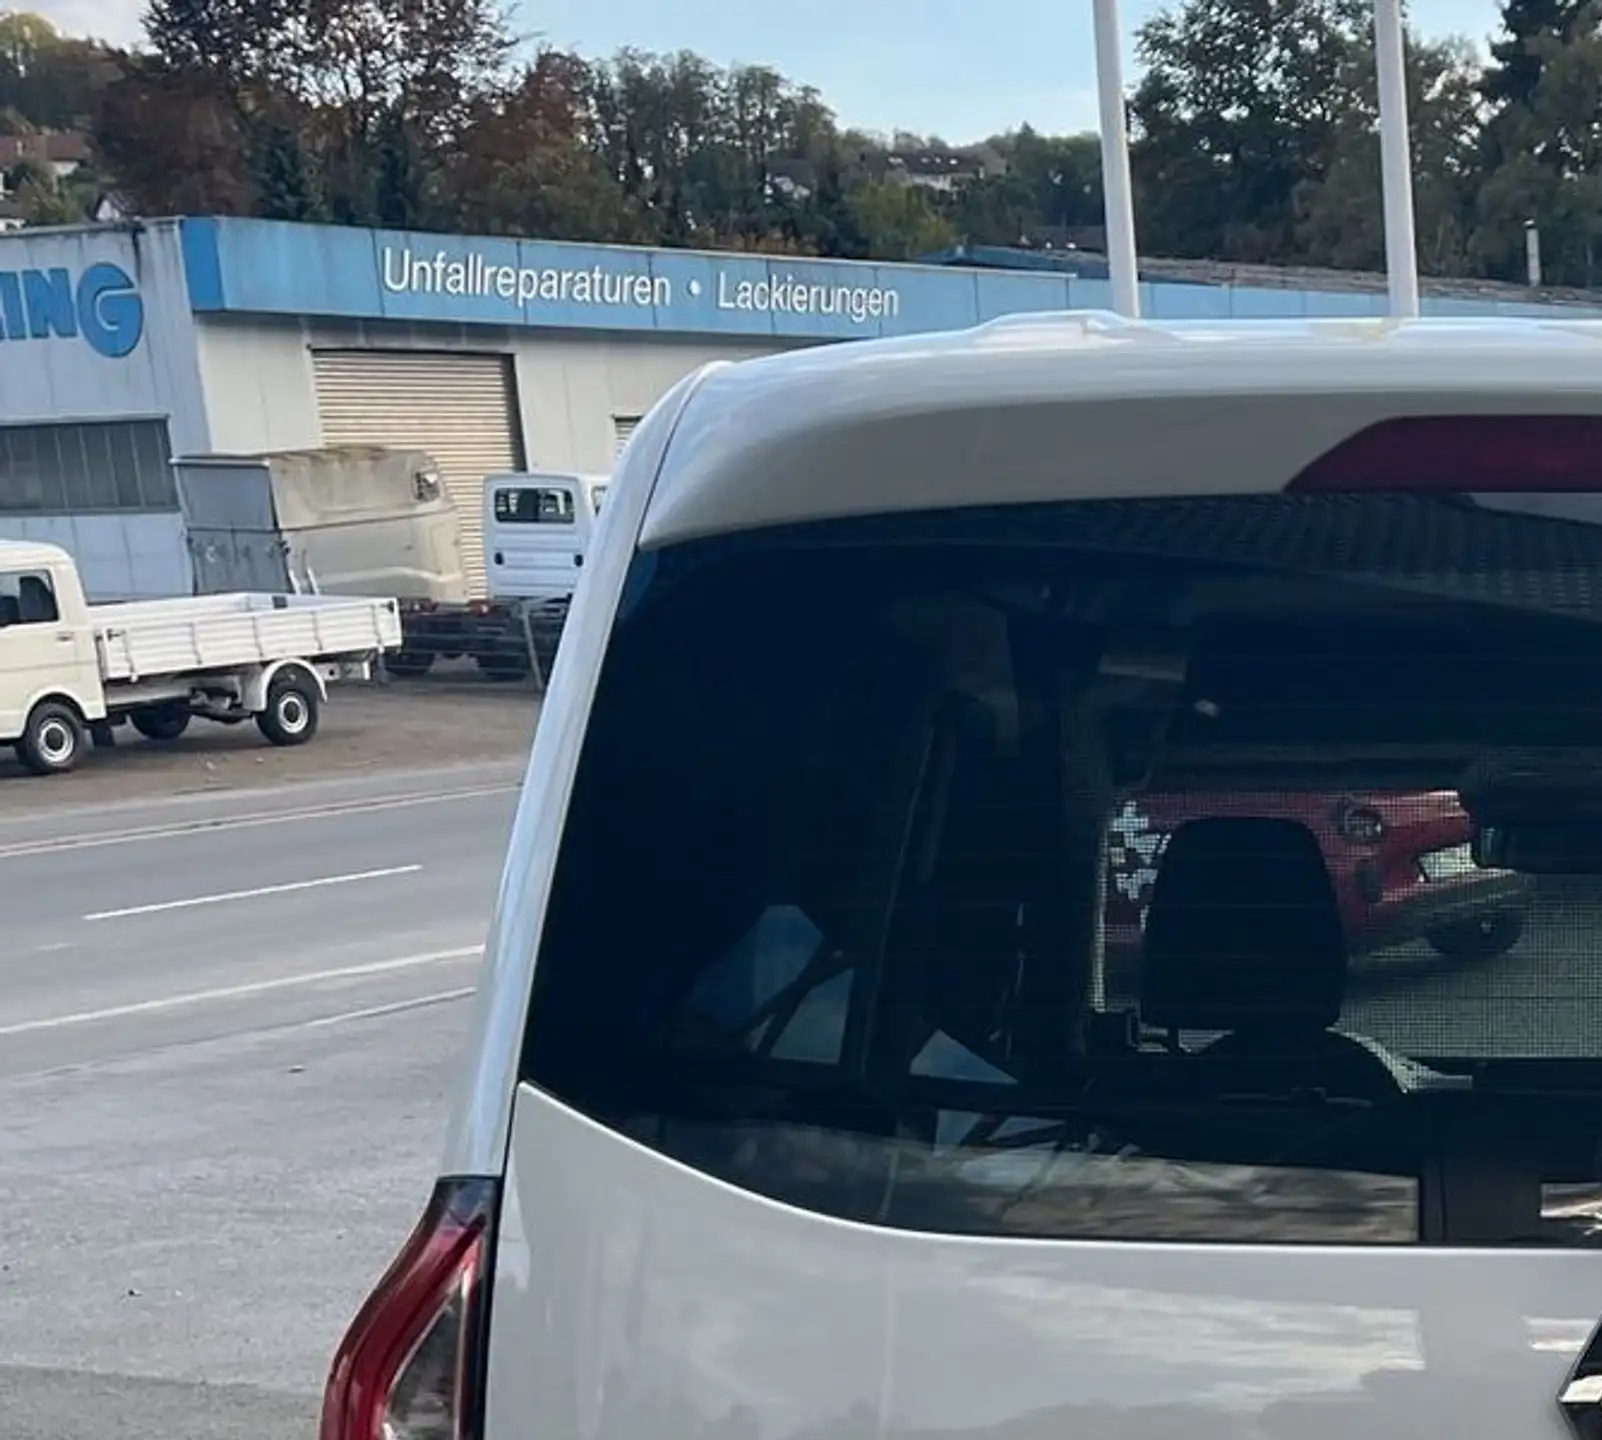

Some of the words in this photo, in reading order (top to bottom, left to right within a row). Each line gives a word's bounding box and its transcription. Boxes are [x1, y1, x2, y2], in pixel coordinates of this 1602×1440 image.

[0, 261, 144, 359] ING
[384, 247, 671, 307] Unfallreparaturen
[718, 271, 899, 322] Lackierungen
